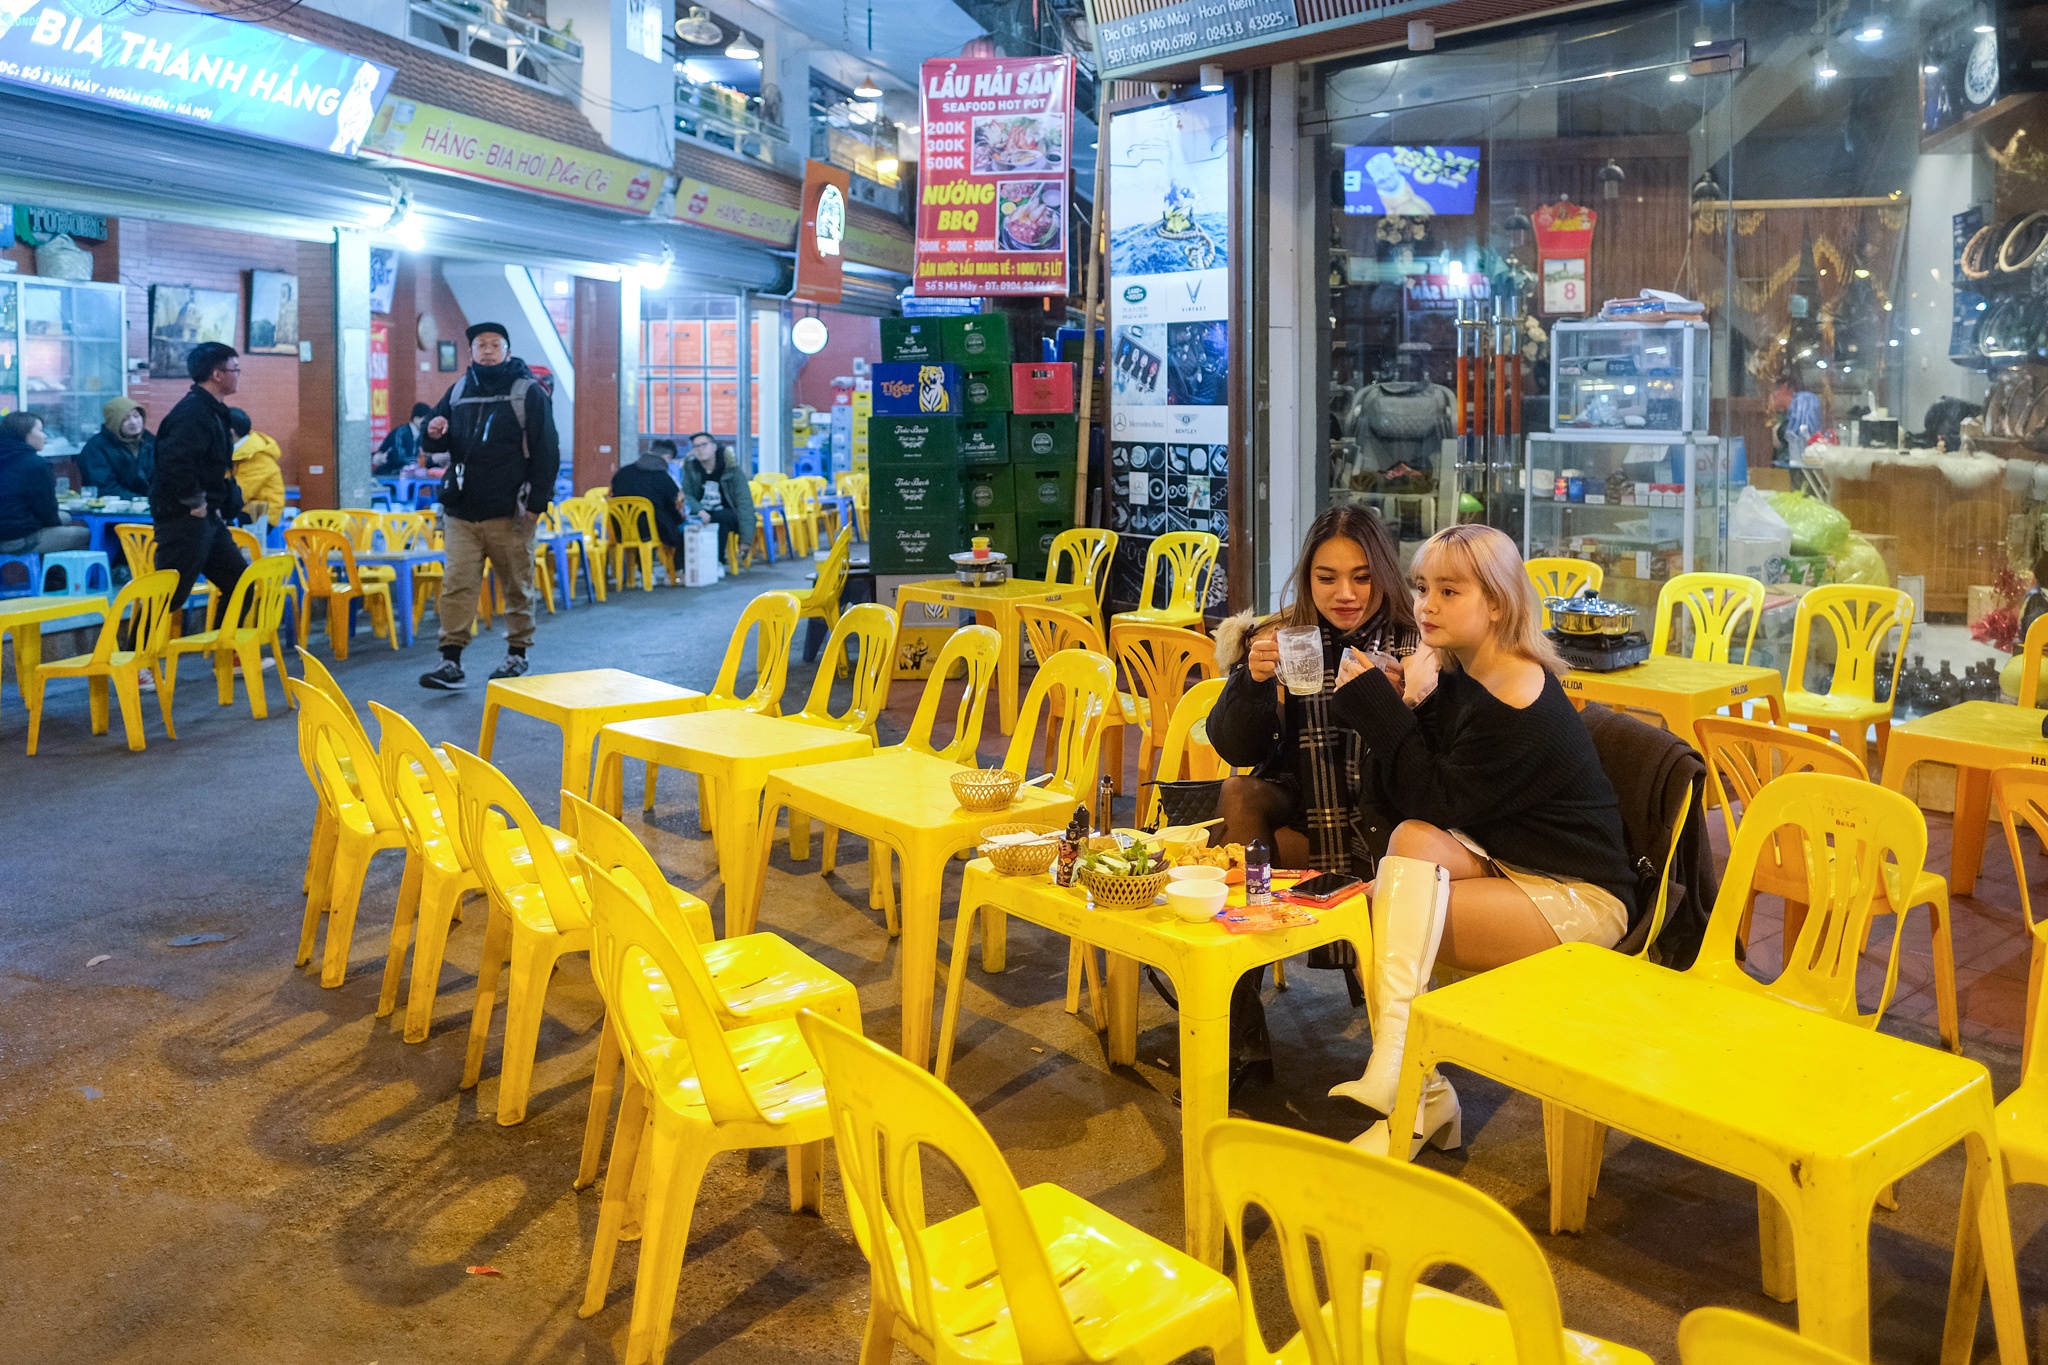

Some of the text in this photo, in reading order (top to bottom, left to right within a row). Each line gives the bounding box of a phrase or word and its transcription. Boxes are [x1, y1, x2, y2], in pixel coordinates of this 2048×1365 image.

[1103, 26, 1121, 44] Địa
[1140, 21, 1148, 33] 5
[1149, 16, 1167, 32] Mã
[1170, 11, 1190, 29] Mây
[1199, 2, 1227, 19] Hoàn
[31, 8, 102, 58] BIA
[119, 31, 248, 92] THANH
[1130, 43, 1150, 60] 090
[1150, 32, 1198, 54] 990.6789
[928, 62, 1061, 99] LẨU HẢI SẢN
[942, 98, 1046, 113] SEAFOOD HOT POT
[927, 121, 966, 135] 200K
[927, 139, 966, 152] 300K
[485, 144, 513, 171] BIA
[516, 152, 547, 178] HƠI
[545, 157, 581, 186] Phố
[926, 156, 965, 170] 500K
[922, 179, 995, 206] NƯỚNG
[30, 207, 108, 238] TUBORG
[937, 211, 979, 233] BBQ
[945, 281, 958, 290] Mã
[1564, 282, 1577, 300] 8
[881, 380, 915, 399] Tiger
[1129, 420, 1164, 428] Mercedes-Benz
[1731, 684, 1749, 697] HALIDA
